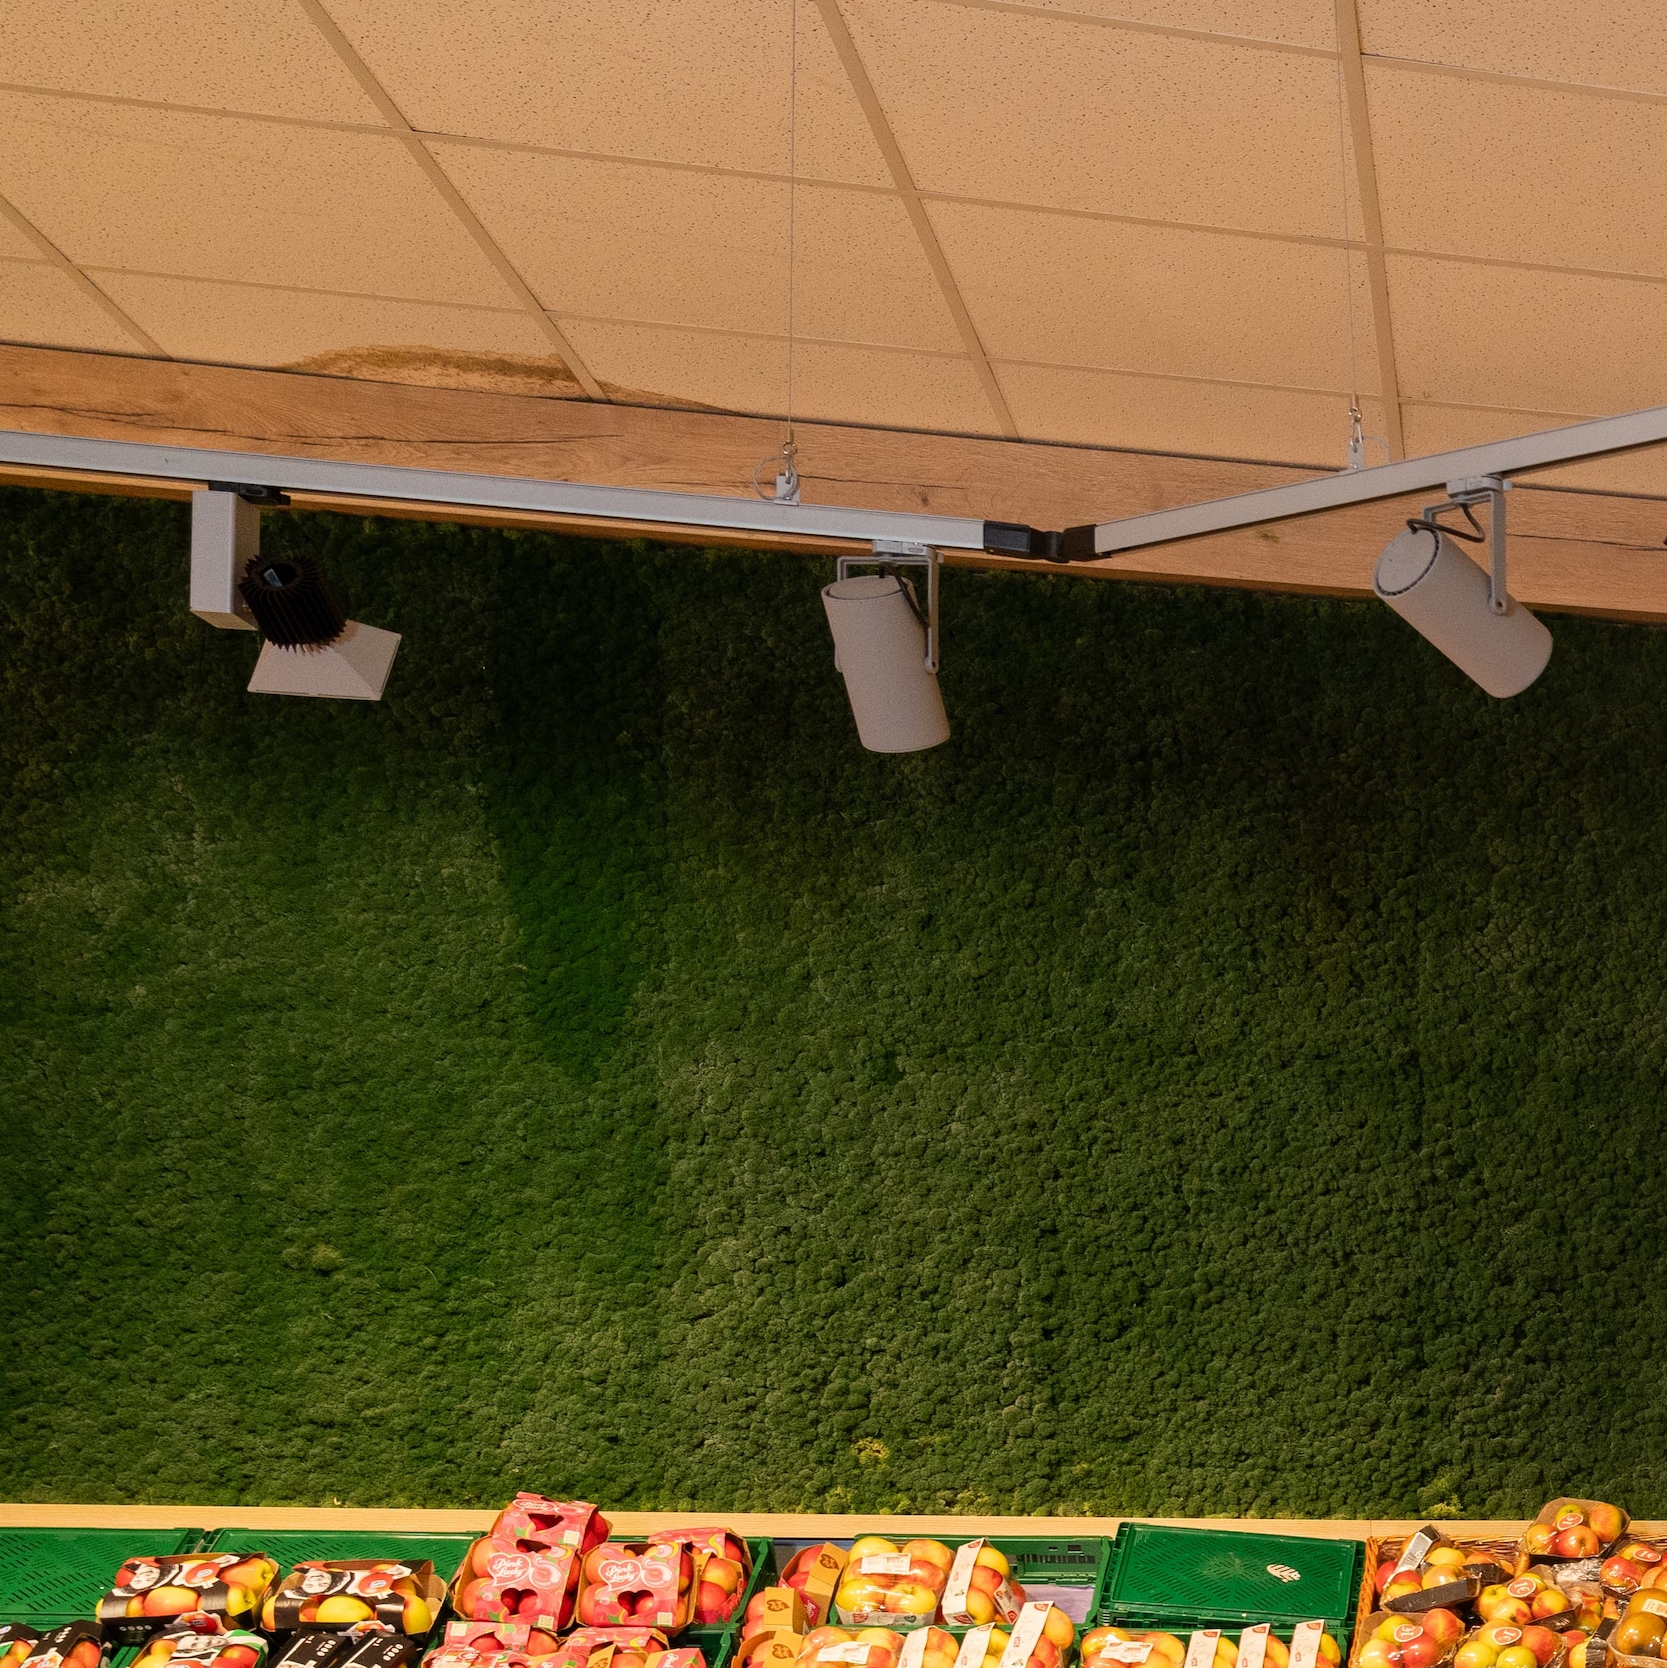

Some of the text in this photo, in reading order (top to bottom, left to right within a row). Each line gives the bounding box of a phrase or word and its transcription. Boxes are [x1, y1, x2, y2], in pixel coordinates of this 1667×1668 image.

[494, 1559, 523, 1573] Pink
[605, 1565, 633, 1579] Pink
[496, 1568, 527, 1583] Lady
[610, 1573, 639, 1588] Lady
